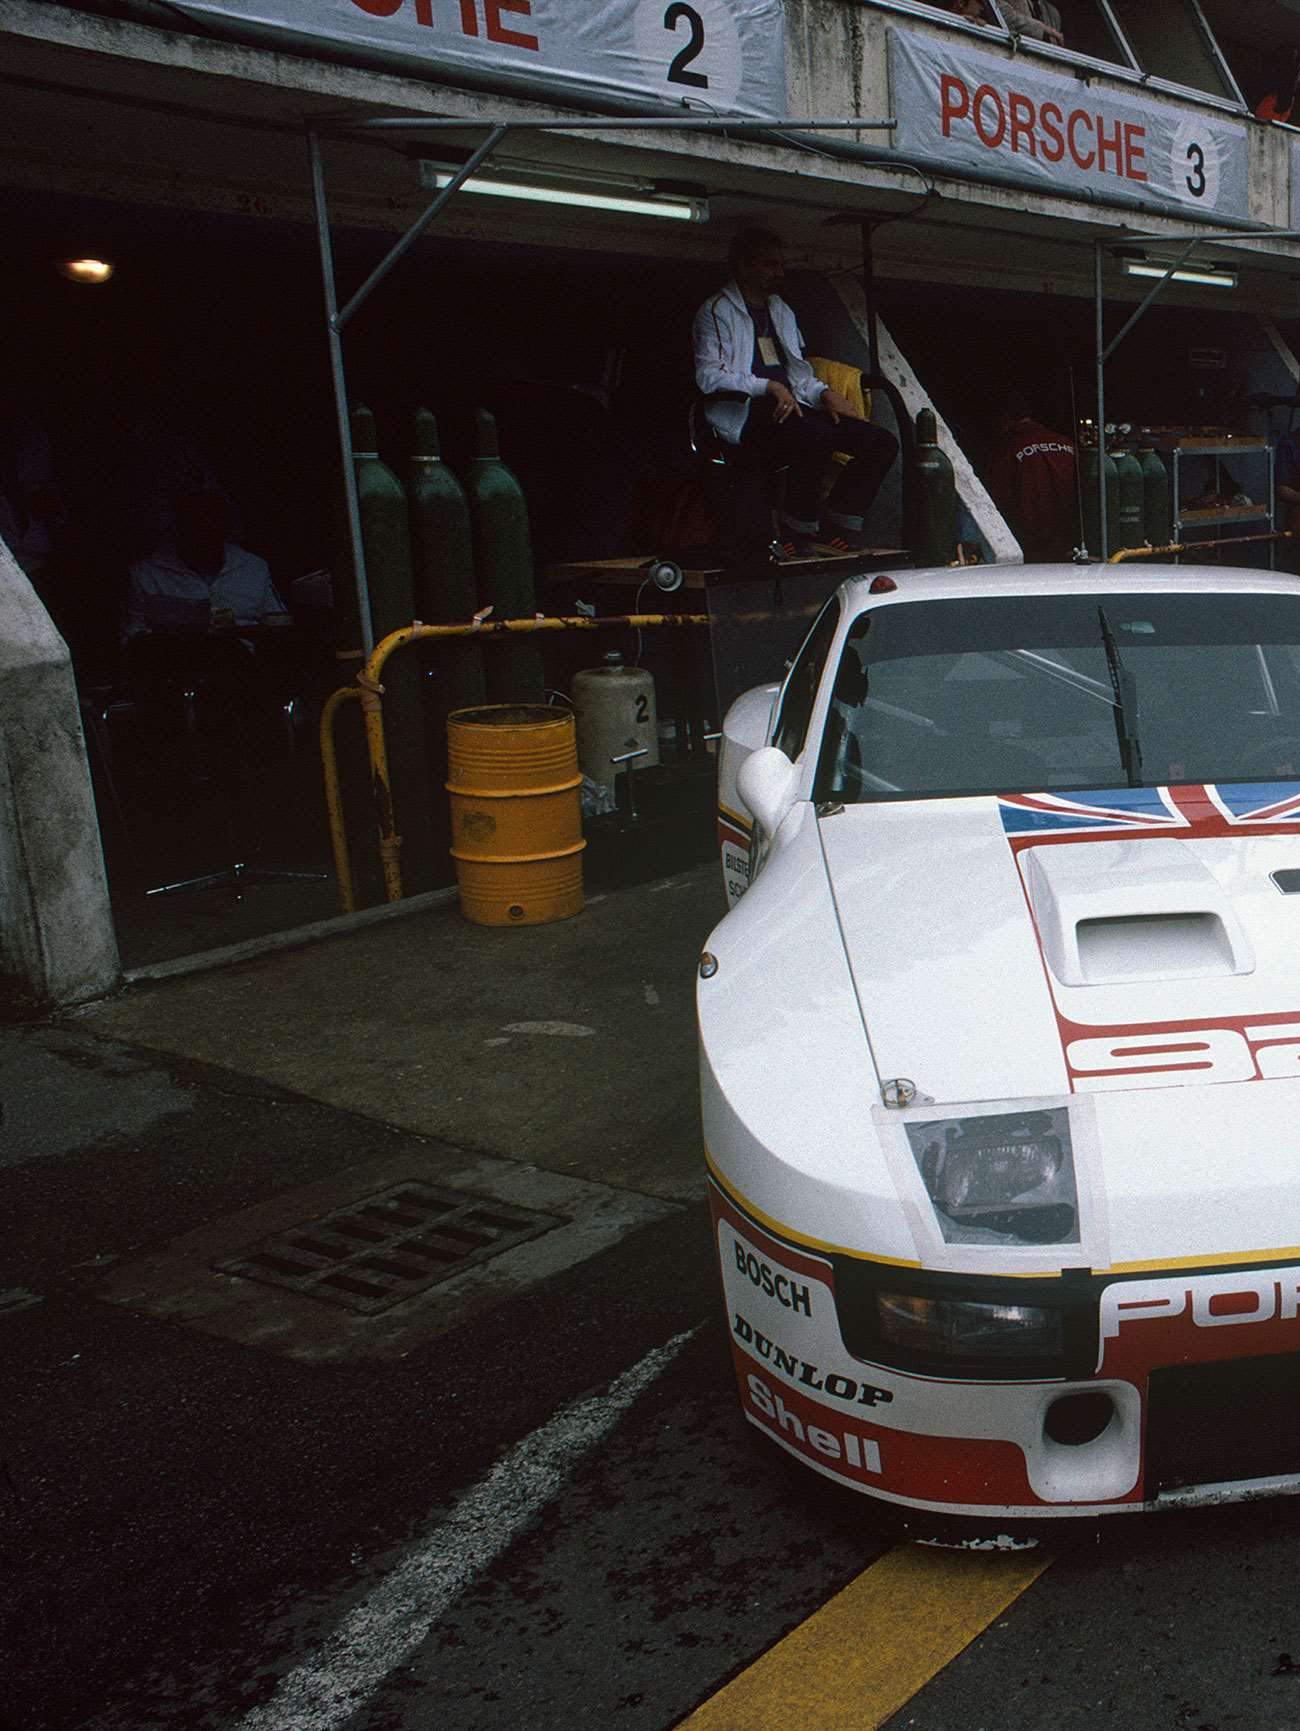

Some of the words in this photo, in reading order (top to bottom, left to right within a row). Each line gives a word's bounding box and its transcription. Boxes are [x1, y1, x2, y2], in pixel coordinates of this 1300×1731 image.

[664, 2, 708, 89] 2
[940, 73, 1148, 182] PORSCHE
[1185, 142, 1206, 197] 3
[636, 694, 649, 723] 2
[725, 853, 751, 877] BILSTE
[734, 1239, 813, 1318] BOSCH
[733, 1313, 895, 1408] DUNLOP
[746, 1372, 883, 1475] Shell
